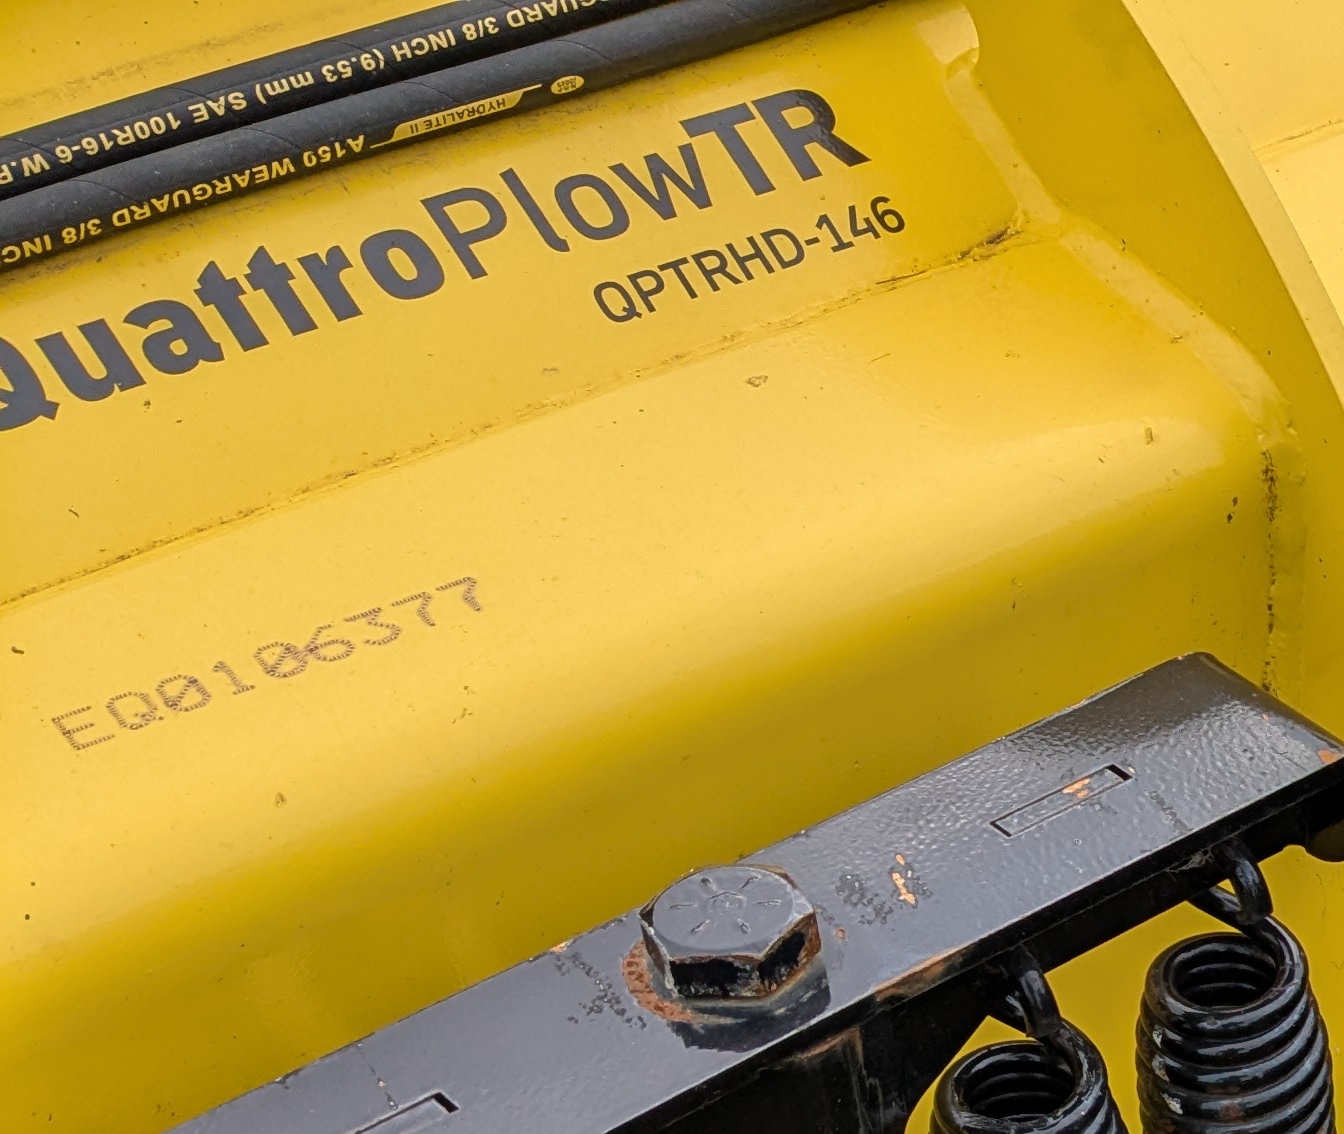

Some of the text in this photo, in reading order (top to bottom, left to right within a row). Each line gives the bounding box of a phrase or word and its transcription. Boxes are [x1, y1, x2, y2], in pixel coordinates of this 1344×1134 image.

[391, 29, 456, 63] INCH
[463, 16, 500, 42] 3/8
[321, 48, 386, 84] (9.53
[255, 71, 315, 105] mm)
[187, 91, 248, 124] SAE
[424, 97, 507, 130] HYDRALITE
[54, 111, 182, 164] 100R16-6
[303, 134, 366, 168] A150
[112, 157, 297, 227] WEARGUARD
[61, 218, 102, 245] 3/8
[593, 195, 906, 323] QPTRHD-146
[51, 576, 482, 751] EQ0106377
